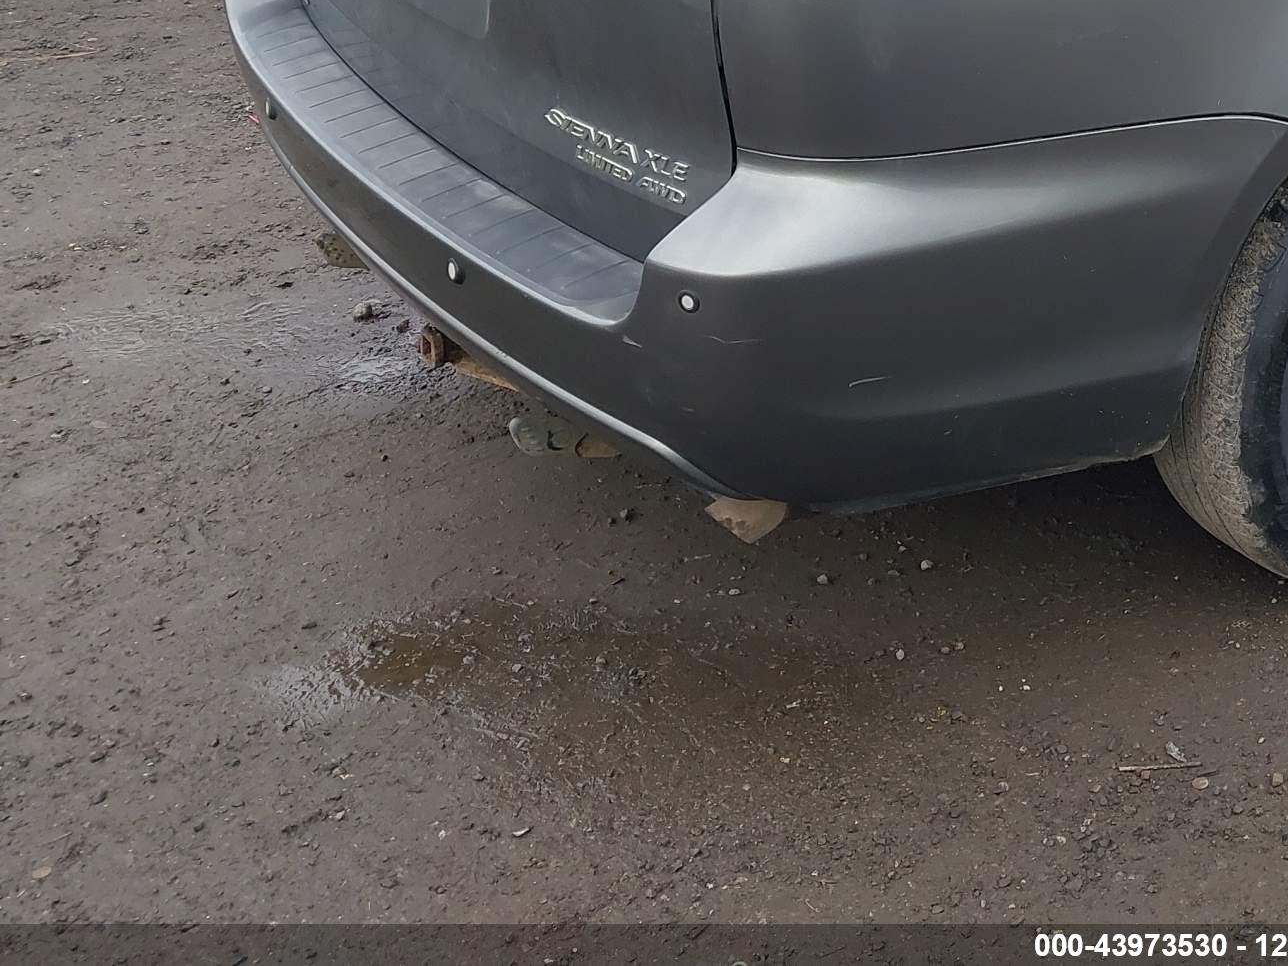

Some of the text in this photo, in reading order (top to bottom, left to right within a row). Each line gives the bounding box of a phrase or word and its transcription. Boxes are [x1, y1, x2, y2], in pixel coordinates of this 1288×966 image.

[544, 107, 690, 181] SIENNA XLE
[575, 144, 687, 205] LIMITED AWD
